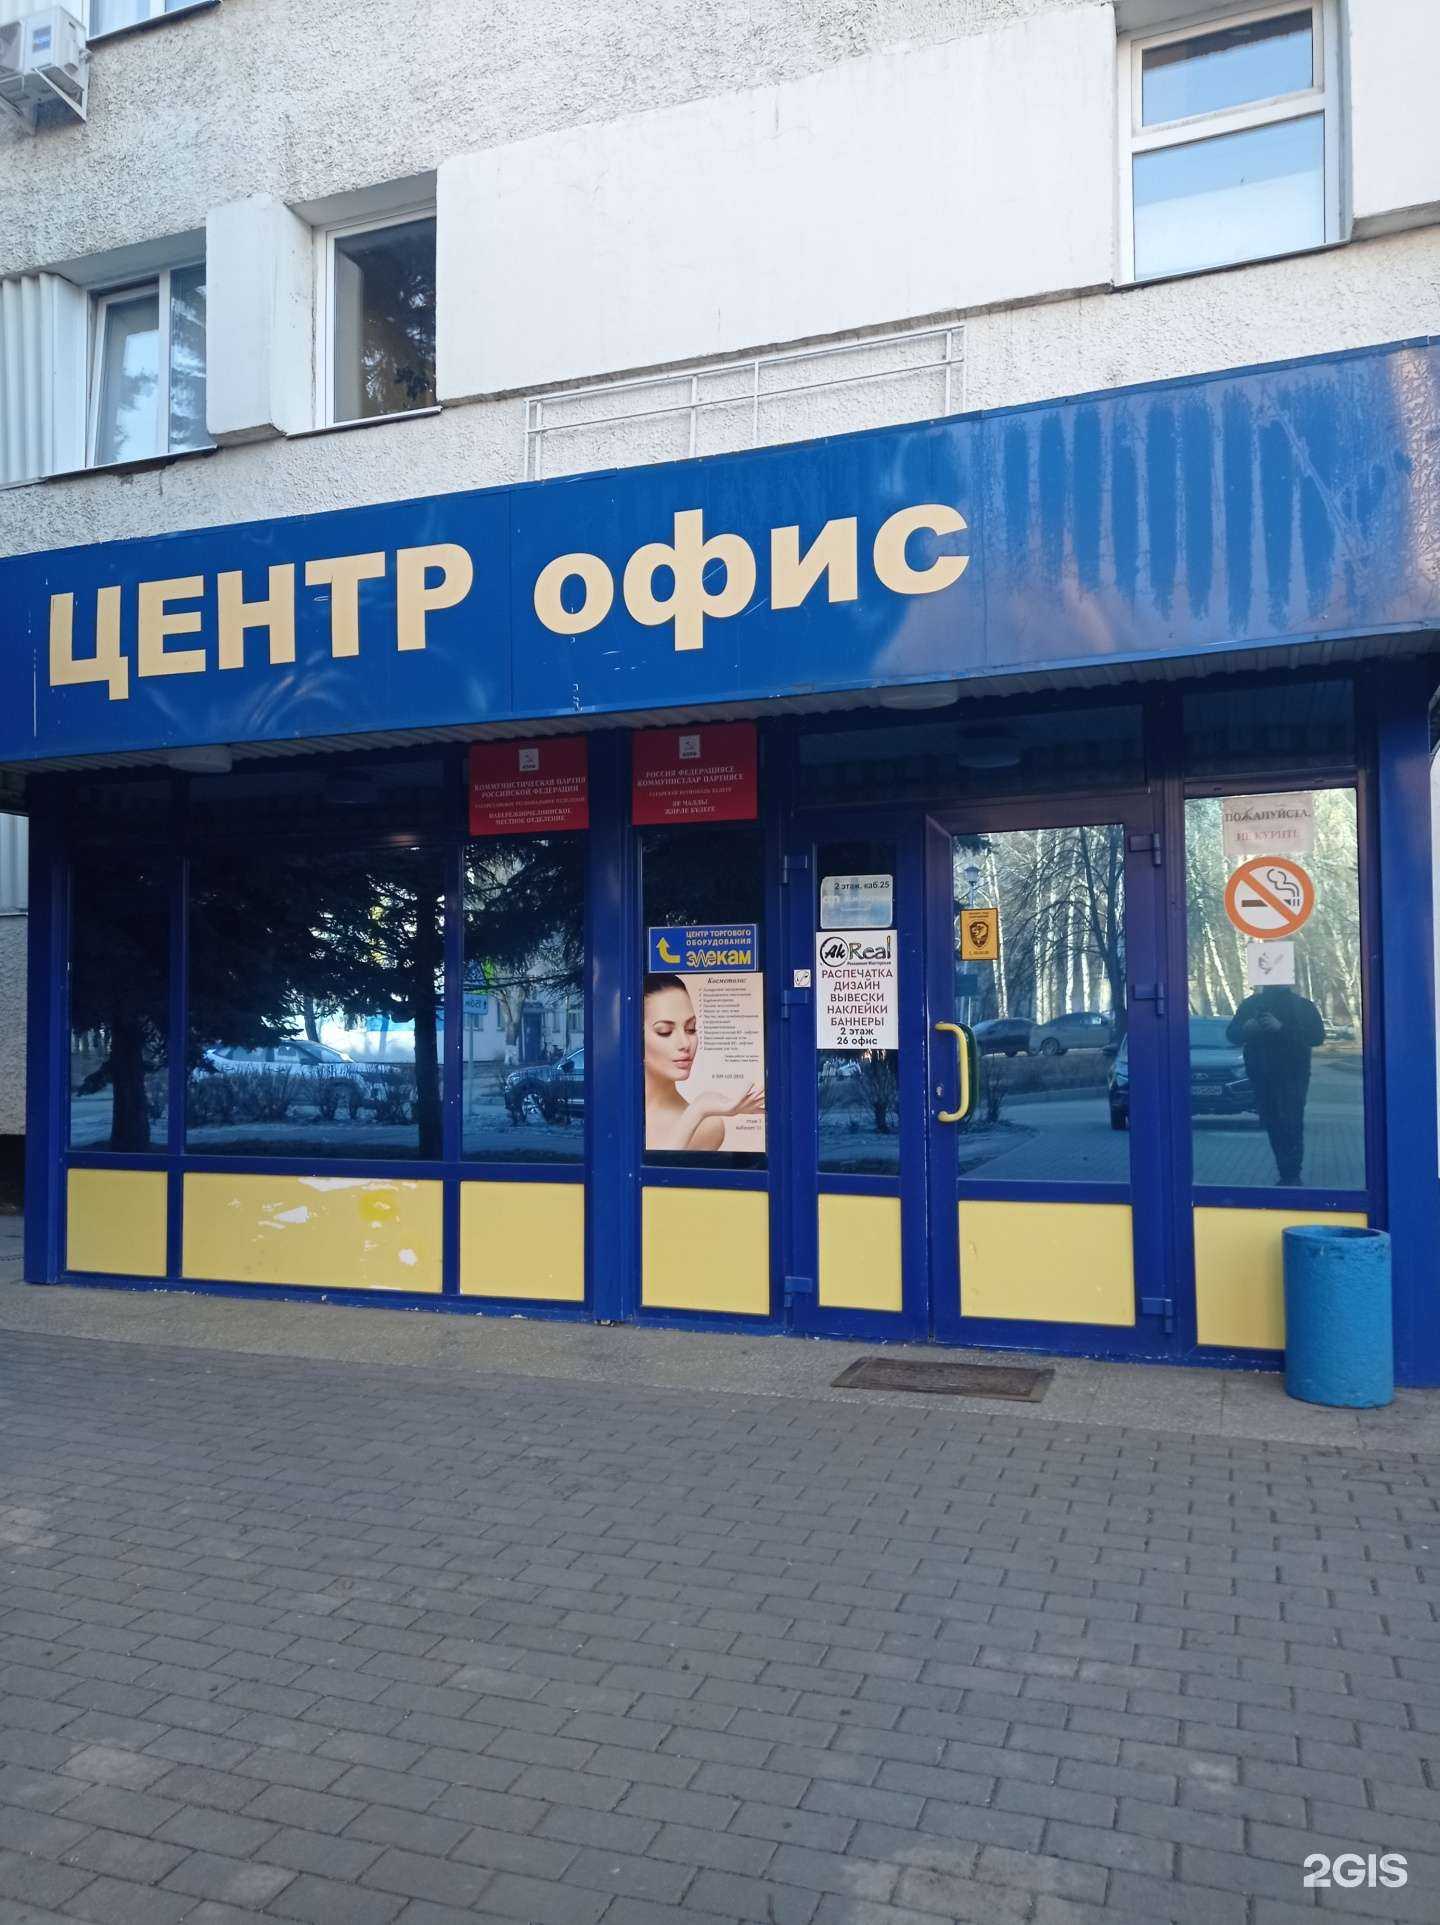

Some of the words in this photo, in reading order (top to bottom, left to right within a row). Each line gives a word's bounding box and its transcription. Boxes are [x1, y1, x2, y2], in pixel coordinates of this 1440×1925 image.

[50, 545, 474, 701] ЦЕНТР
[535, 505, 966, 650] офис
[834, 882, 841, 890] 2
[686, 930, 708, 938] ЦЕНТР
[710, 929, 751, 937] ТОРГОВОГО
[686, 938, 751, 946] ОБОРУДОВАНИЯ
[849, 935, 891, 960] Real
[822, 968, 893, 978] РАСПЕЧАТКА
[834, 978, 880, 992] ДИЗАЙН
[830, 993, 884, 1002] ВЫВЕСКИ
[827, 1002, 888, 1014] НАКЛЕЙКИ
[831, 1016, 884, 1026] БАННЕРЫ
[840, 1027, 846, 1035] 2
[849, 1027, 874, 1035] этаж
[837, 1036, 848, 1045] 26
[851, 1036, 877, 1046] офис
